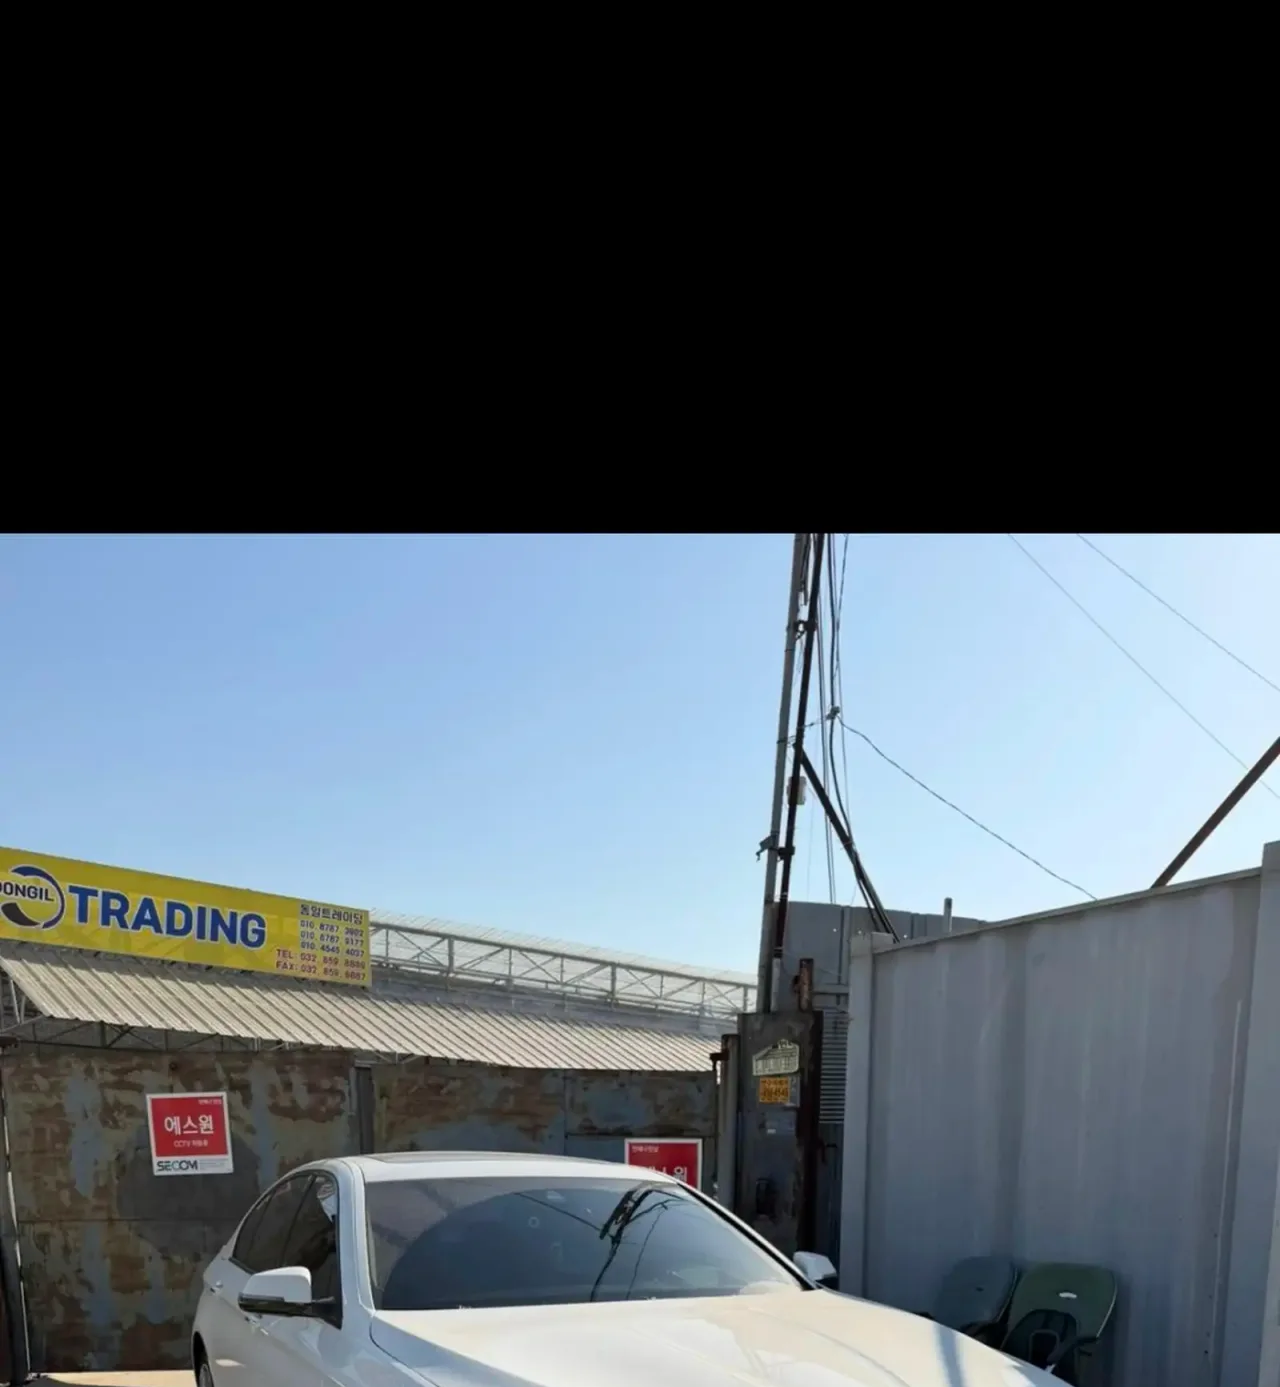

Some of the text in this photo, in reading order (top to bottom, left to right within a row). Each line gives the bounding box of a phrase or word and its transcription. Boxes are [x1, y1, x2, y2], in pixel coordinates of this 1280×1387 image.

[0, 881, 54, 902] ONGIL
[68, 885, 266, 949] TRADING
[300, 903, 363, 925] 동일트레이딩
[164, 1114, 214, 1136] 에스원
[156, 1159, 198, 1172] SECOM
